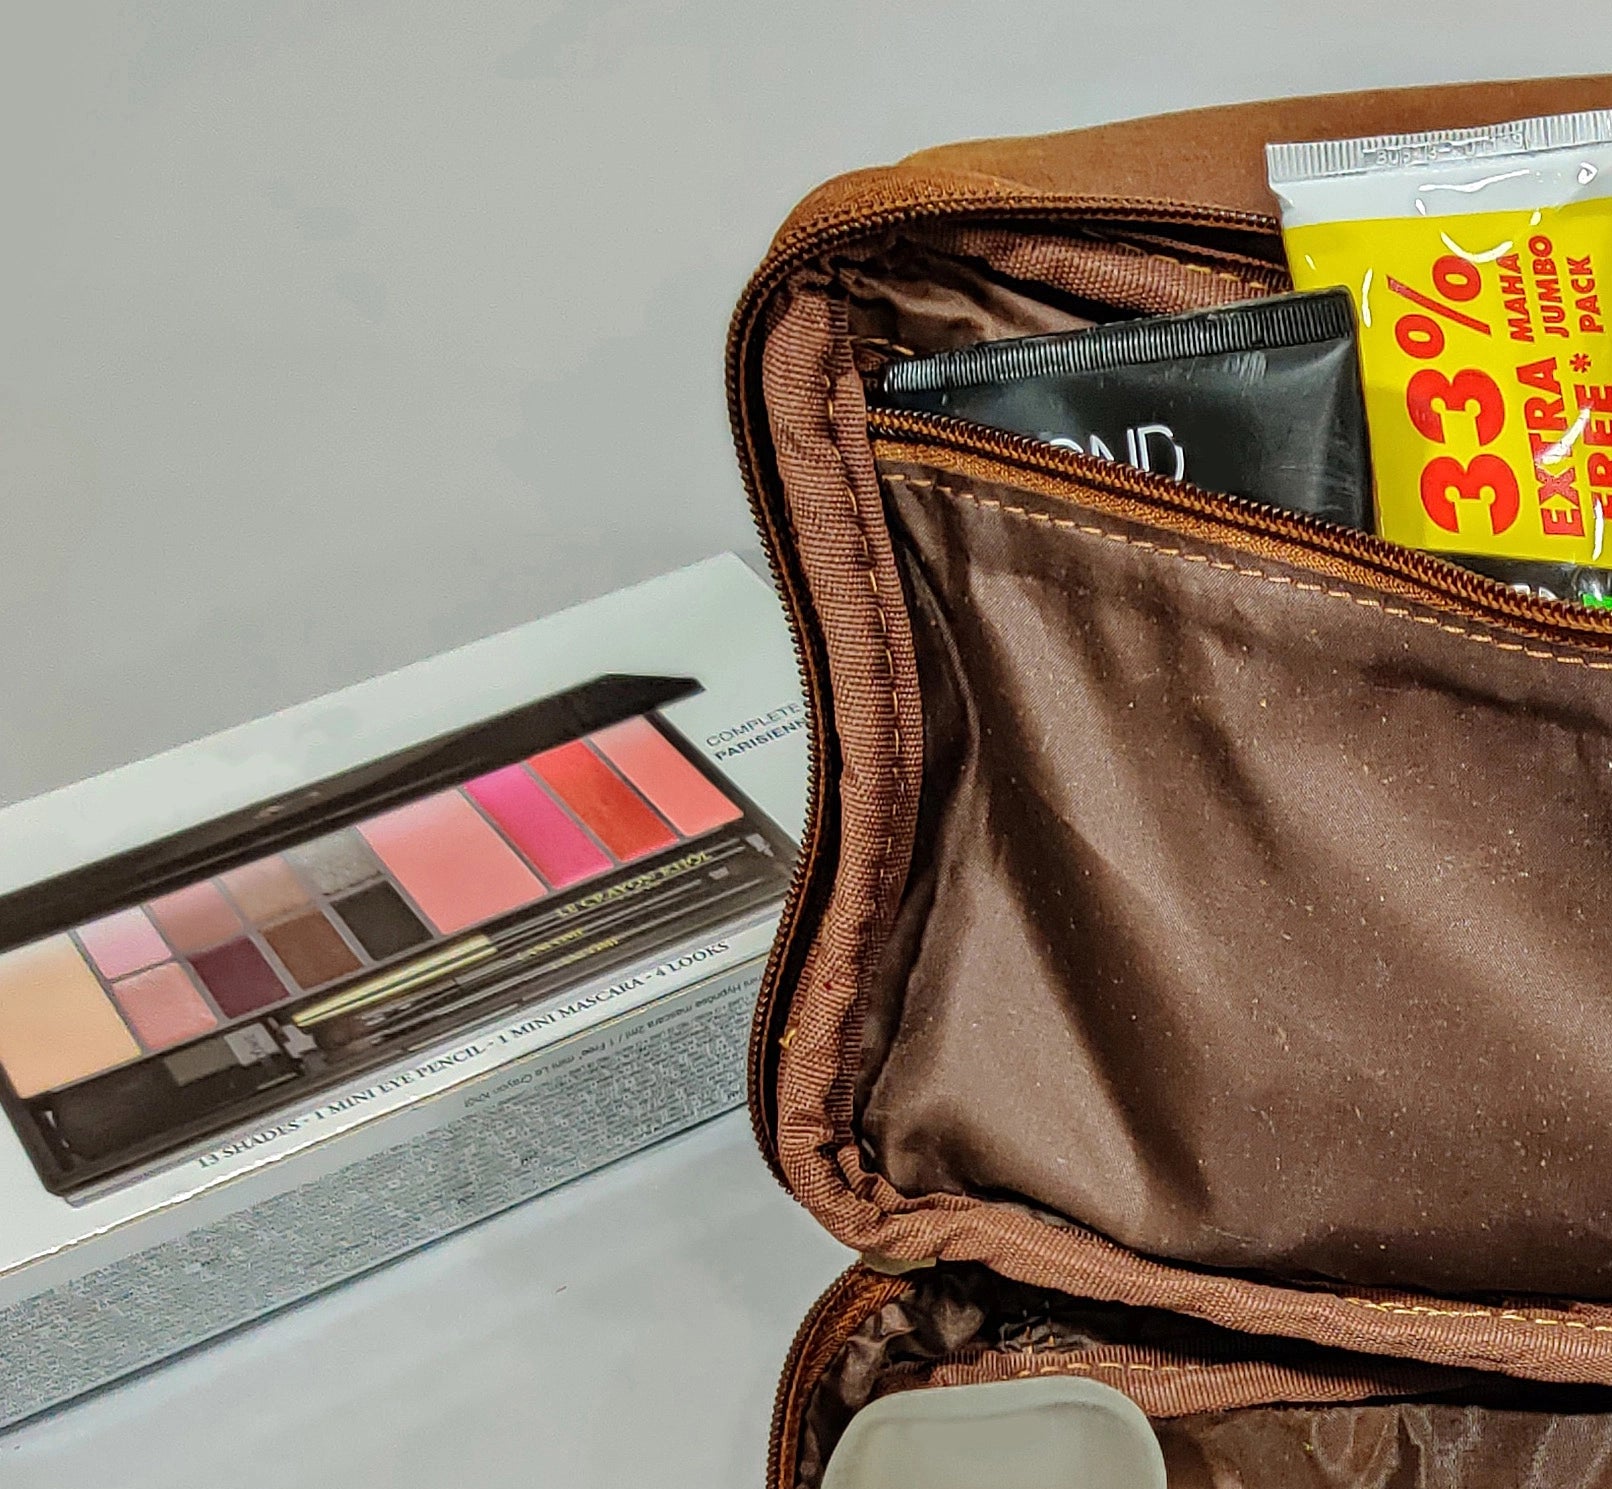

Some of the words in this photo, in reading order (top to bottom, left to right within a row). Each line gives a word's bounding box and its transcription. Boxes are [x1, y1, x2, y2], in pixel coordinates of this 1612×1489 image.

[1496, 252, 1534, 342] MAHA
[1528, 235, 1569, 338] JUMBO
[1567, 254, 1604, 333] PACK
[1386, 254, 1520, 535] 33%
[1516, 356, 1585, 537] EXTRA
[706, 703, 800, 746] COMPLETE
[199, 1155, 220, 1169] 13
[224, 1119, 302, 1159] SHADES
[328, 1087, 376, 1115] MINI
[379, 1073, 415, 1094] EYE
[417, 1044, 487, 1079] PENCIL
[498, 1034, 508, 1044] 1
[510, 1012, 556, 1037] MINI
[558, 978, 645, 1019] MASCARA
[655, 965, 667, 977] 4
[667, 940, 729, 973] LOOKS
